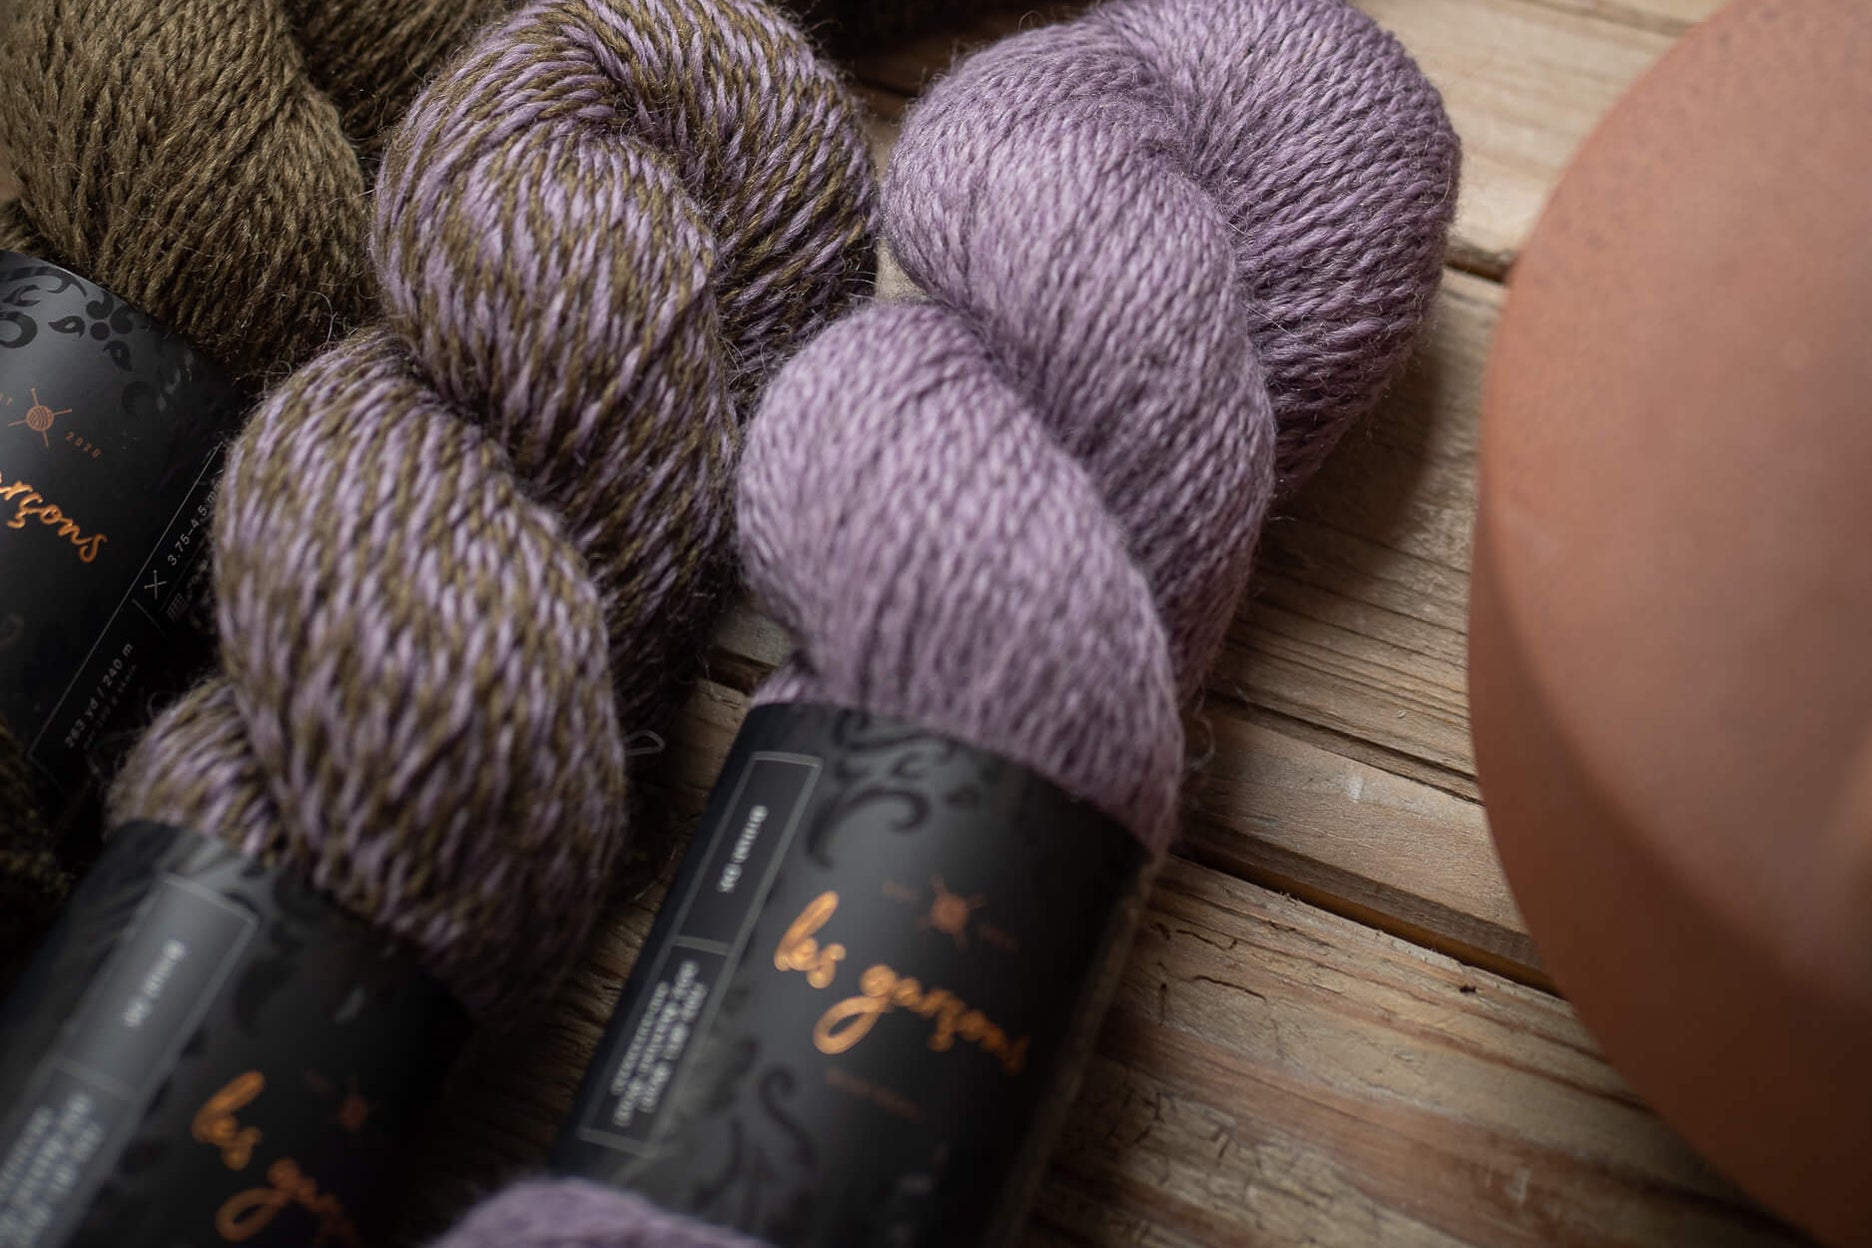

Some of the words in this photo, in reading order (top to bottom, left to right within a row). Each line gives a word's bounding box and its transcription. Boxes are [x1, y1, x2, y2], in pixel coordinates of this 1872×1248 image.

[65, 431, 101, 459] 2020
[103, 658, 123, 687] 240
[122, 643, 134, 657] m
